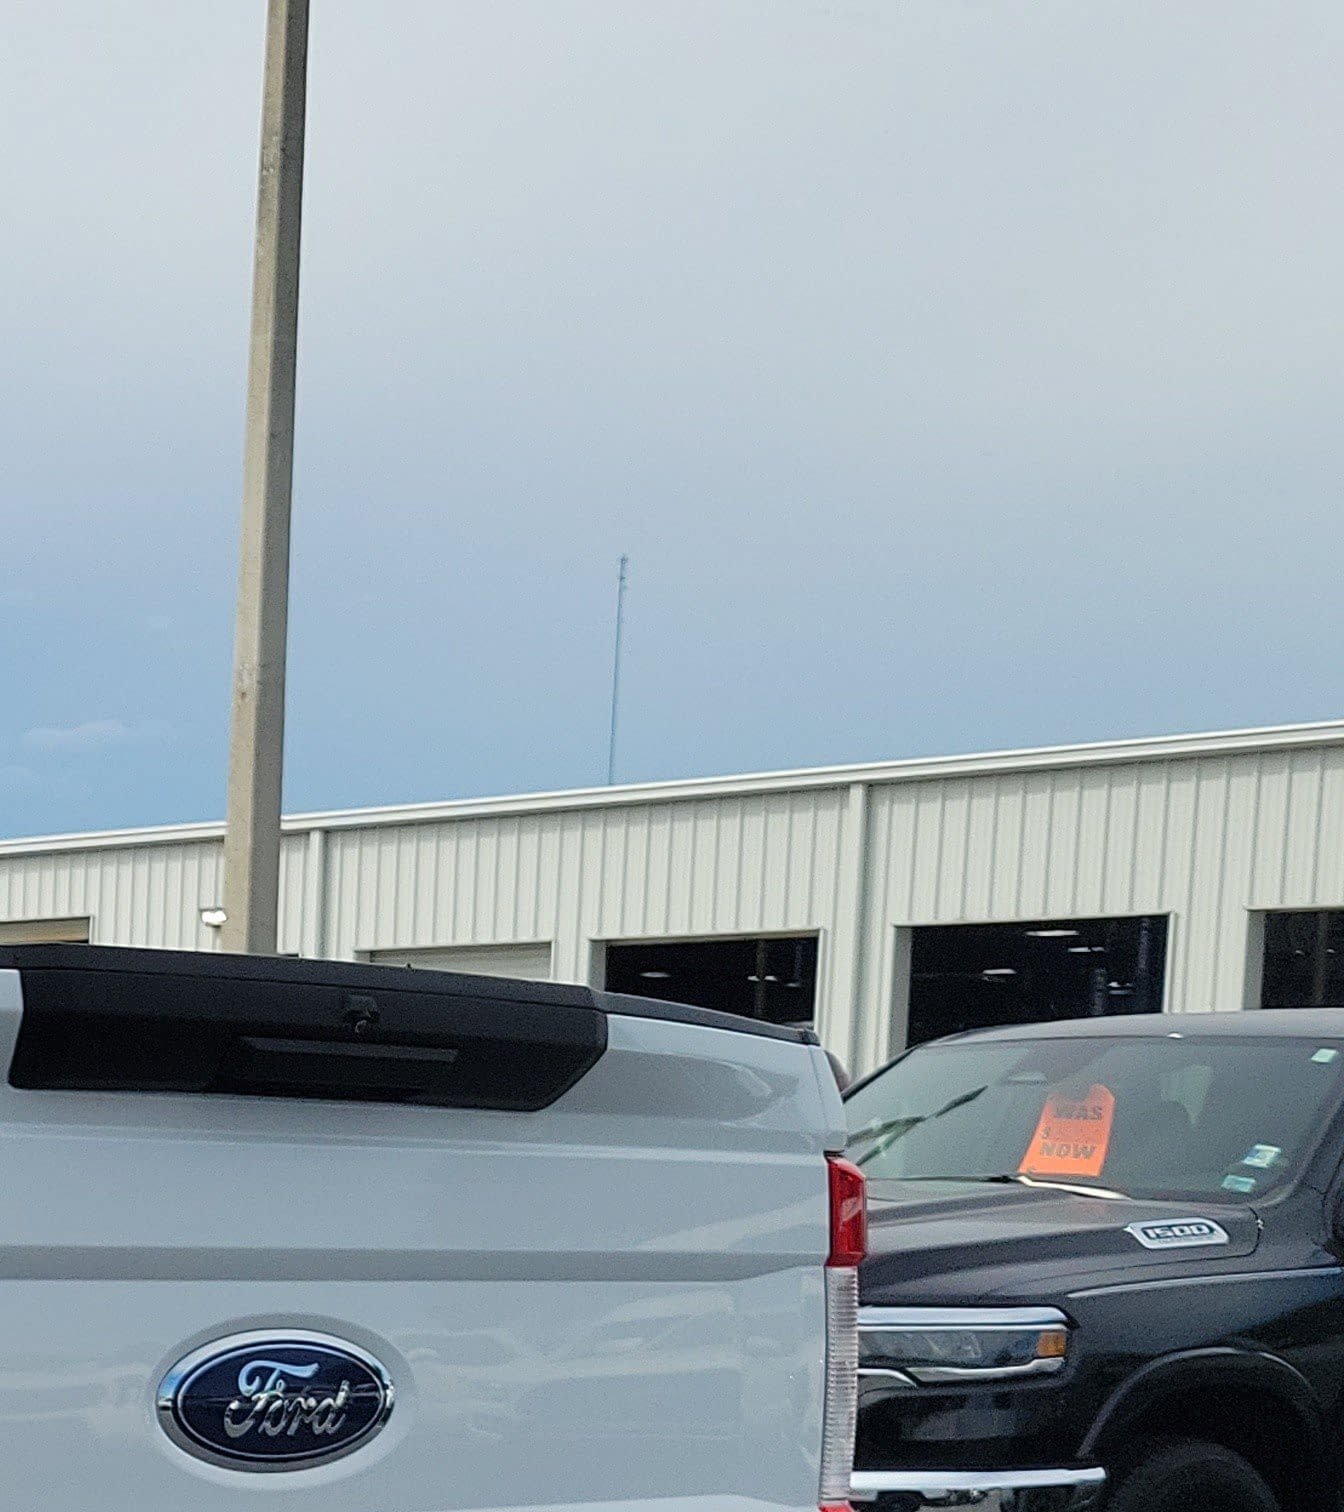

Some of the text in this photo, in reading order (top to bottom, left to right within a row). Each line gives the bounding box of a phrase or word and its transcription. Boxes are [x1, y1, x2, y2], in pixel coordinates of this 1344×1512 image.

[1040, 1143, 1096, 1159] NOW
[1143, 1223, 1210, 1240] 1500
[223, 1360, 351, 1438] Ford
